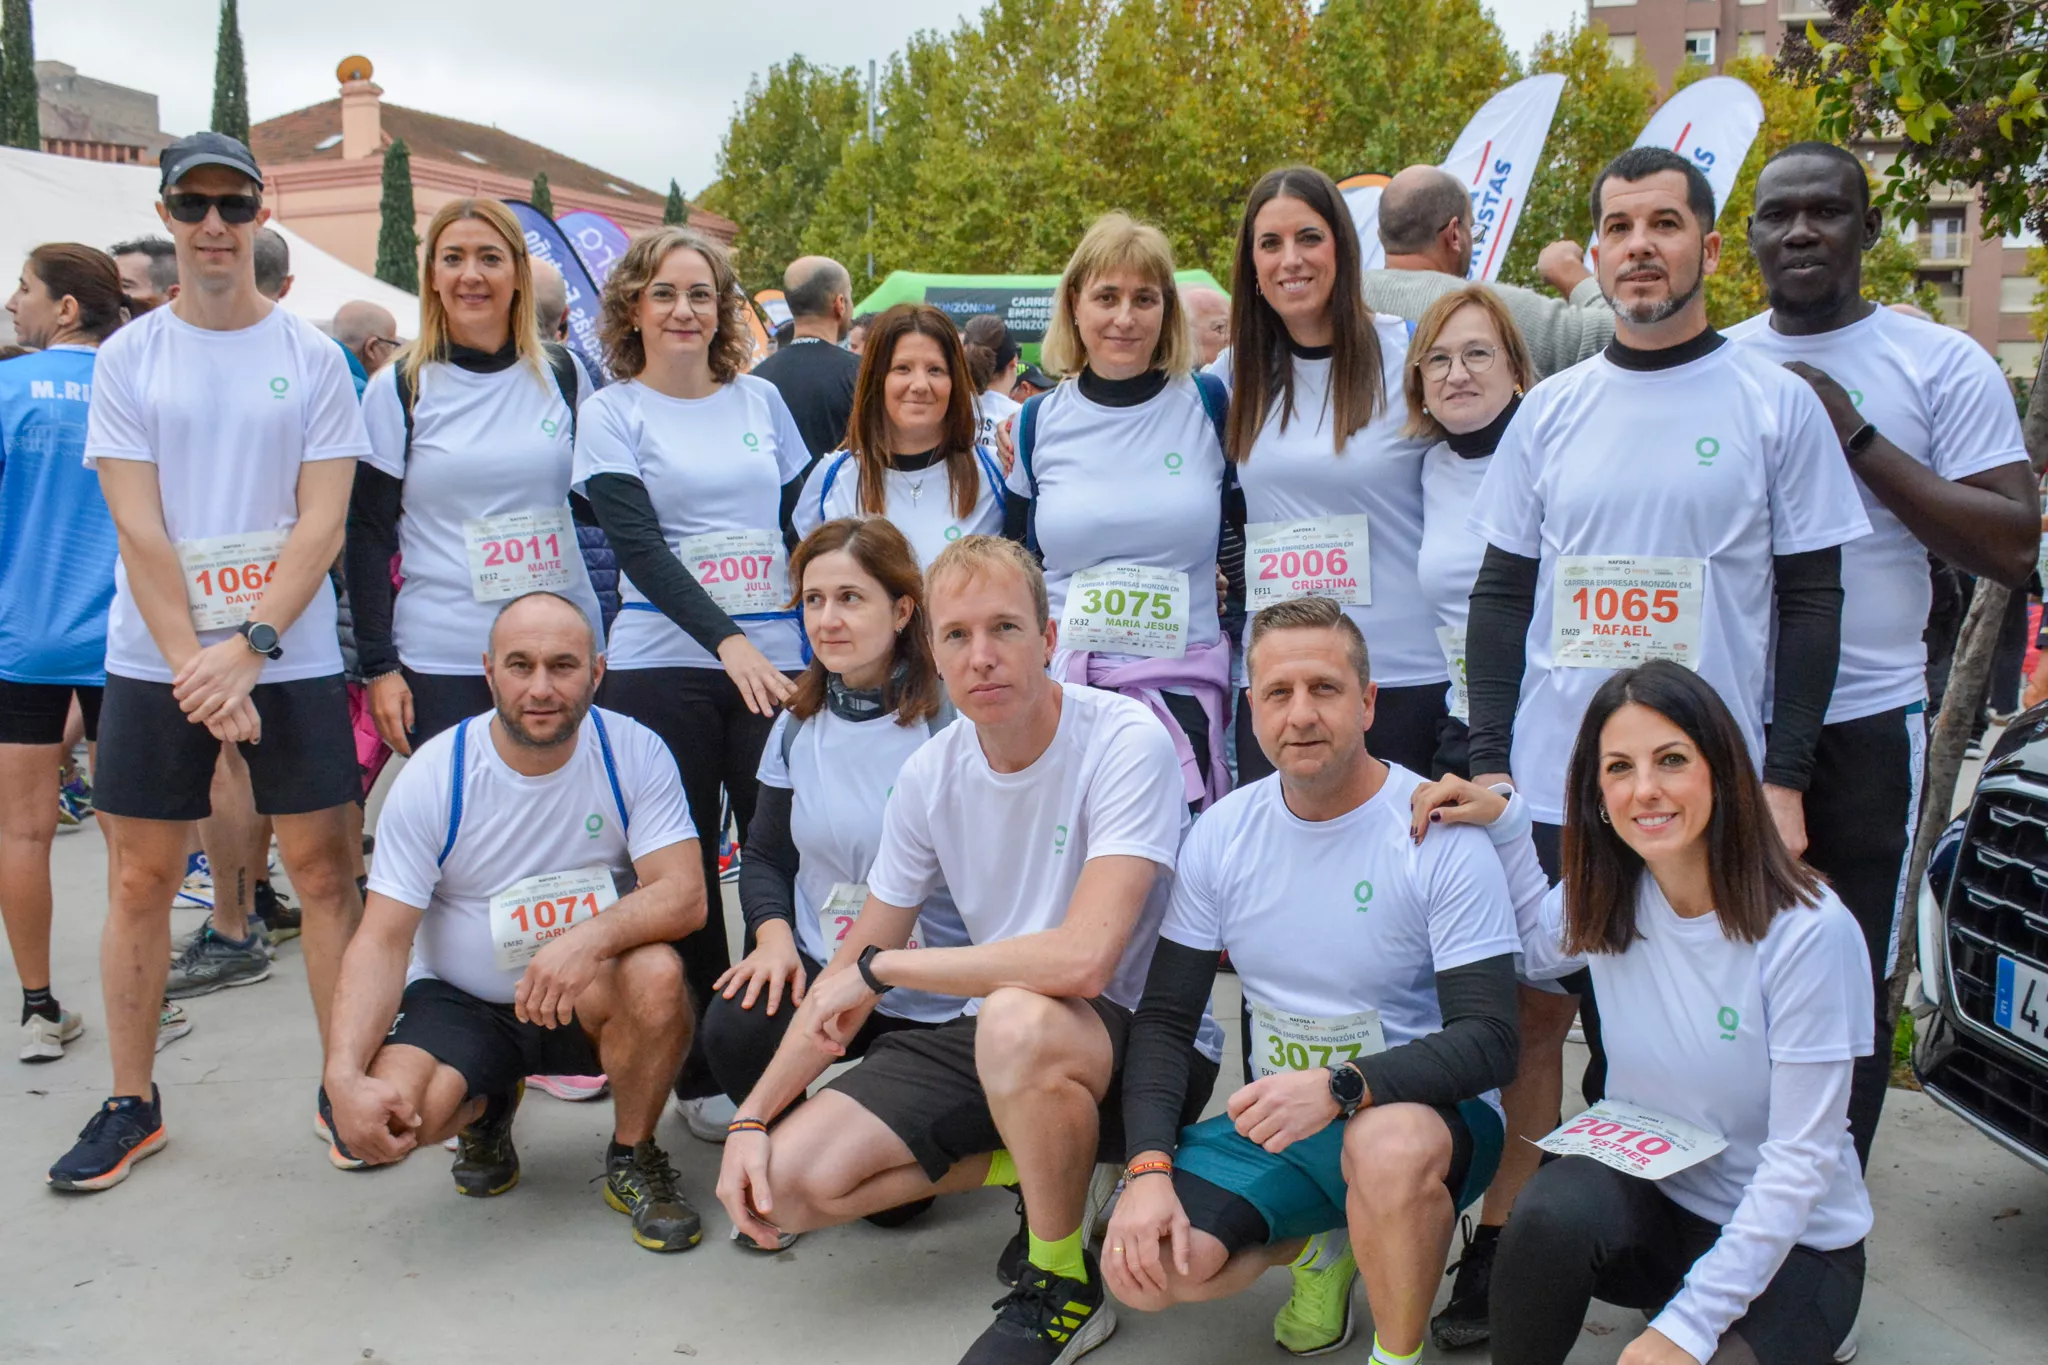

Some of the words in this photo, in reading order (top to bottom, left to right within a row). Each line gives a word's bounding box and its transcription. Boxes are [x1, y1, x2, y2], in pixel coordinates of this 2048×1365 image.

[482, 533, 559, 567] 2011
[480, 572, 498, 582] EF12
[528, 560, 561, 572] MAITE
[698, 555, 773, 585] 2007
[1259, 548, 1348, 580] 2006
[744, 582, 772, 592] JULIA
[1105, 580, 1140, 588] EMPRESAS
[1254, 587, 1271, 596] EF11
[1292, 577, 1357, 591] CRISTINA
[1564, 579, 1595, 587] CARRERA
[1596, 579, 1639, 588] EMPRESAS
[1640, 579, 1677, 588] MONZÓN
[1679, 581, 1692, 589] CM
[225, 592, 264, 605] DAVID
[1081, 589, 1172, 620] 3075
[1572, 587, 1679, 623] 1065
[1069, 618, 1090, 626] EX32
[1105, 618, 1141, 629] MARIA
[1143, 621, 1180, 632] JESUS
[1561, 628, 1580, 636] EM29
[1592, 623, 1652, 637] RAFAEL
[511, 892, 599, 932] 1071
[1283, 1031, 1320, 1042] EMPRESAS
[1321, 1033, 1356, 1043] MONZÓN
[1357, 1030, 1370, 1039] CM
[1268, 1035, 1362, 1071] 3077
[1562, 1117, 1672, 1156] 2010
[1589, 1138, 1652, 1166] ESTHER
